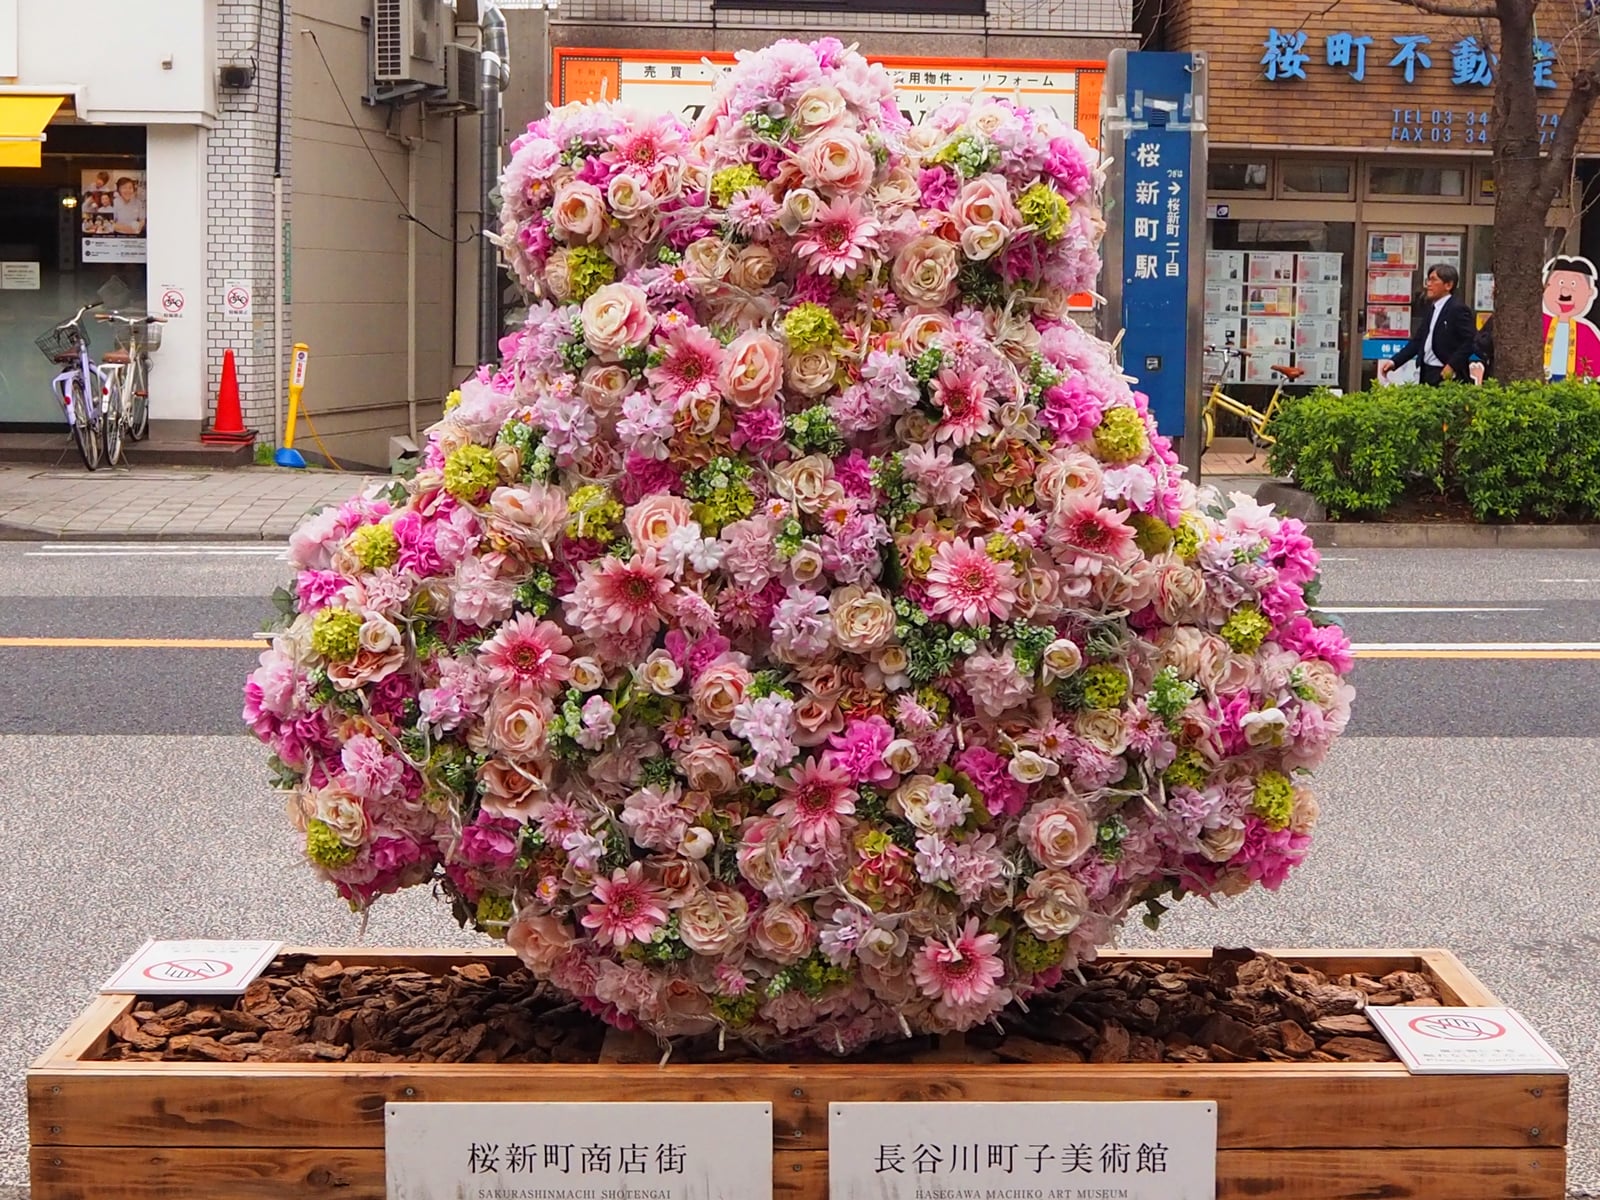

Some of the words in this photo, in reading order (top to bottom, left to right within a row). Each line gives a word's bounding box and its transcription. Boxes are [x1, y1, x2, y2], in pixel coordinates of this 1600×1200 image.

[1392, 109, 1423, 124] TEL
[1391, 127, 1423, 142] FAX
[1134, 142, 1161, 279] 桜新町駅
[1165, 198, 1180, 277] 桜新町一丁目
[467, 1142, 687, 1175] 桜新町商店街
[874, 1142, 1169, 1175] 長谷川町子美術館
[478, 1189, 596, 1200] SAKURASHINMACHI
[601, 1189, 671, 1200] SHOTENGAI
[915, 1189, 982, 1200] HASEGAWA
[985, 1189, 1044, 1200] MACHIKO
[1047, 1189, 1073, 1200] ART
[1076, 1189, 1129, 1200] MUSEUM
